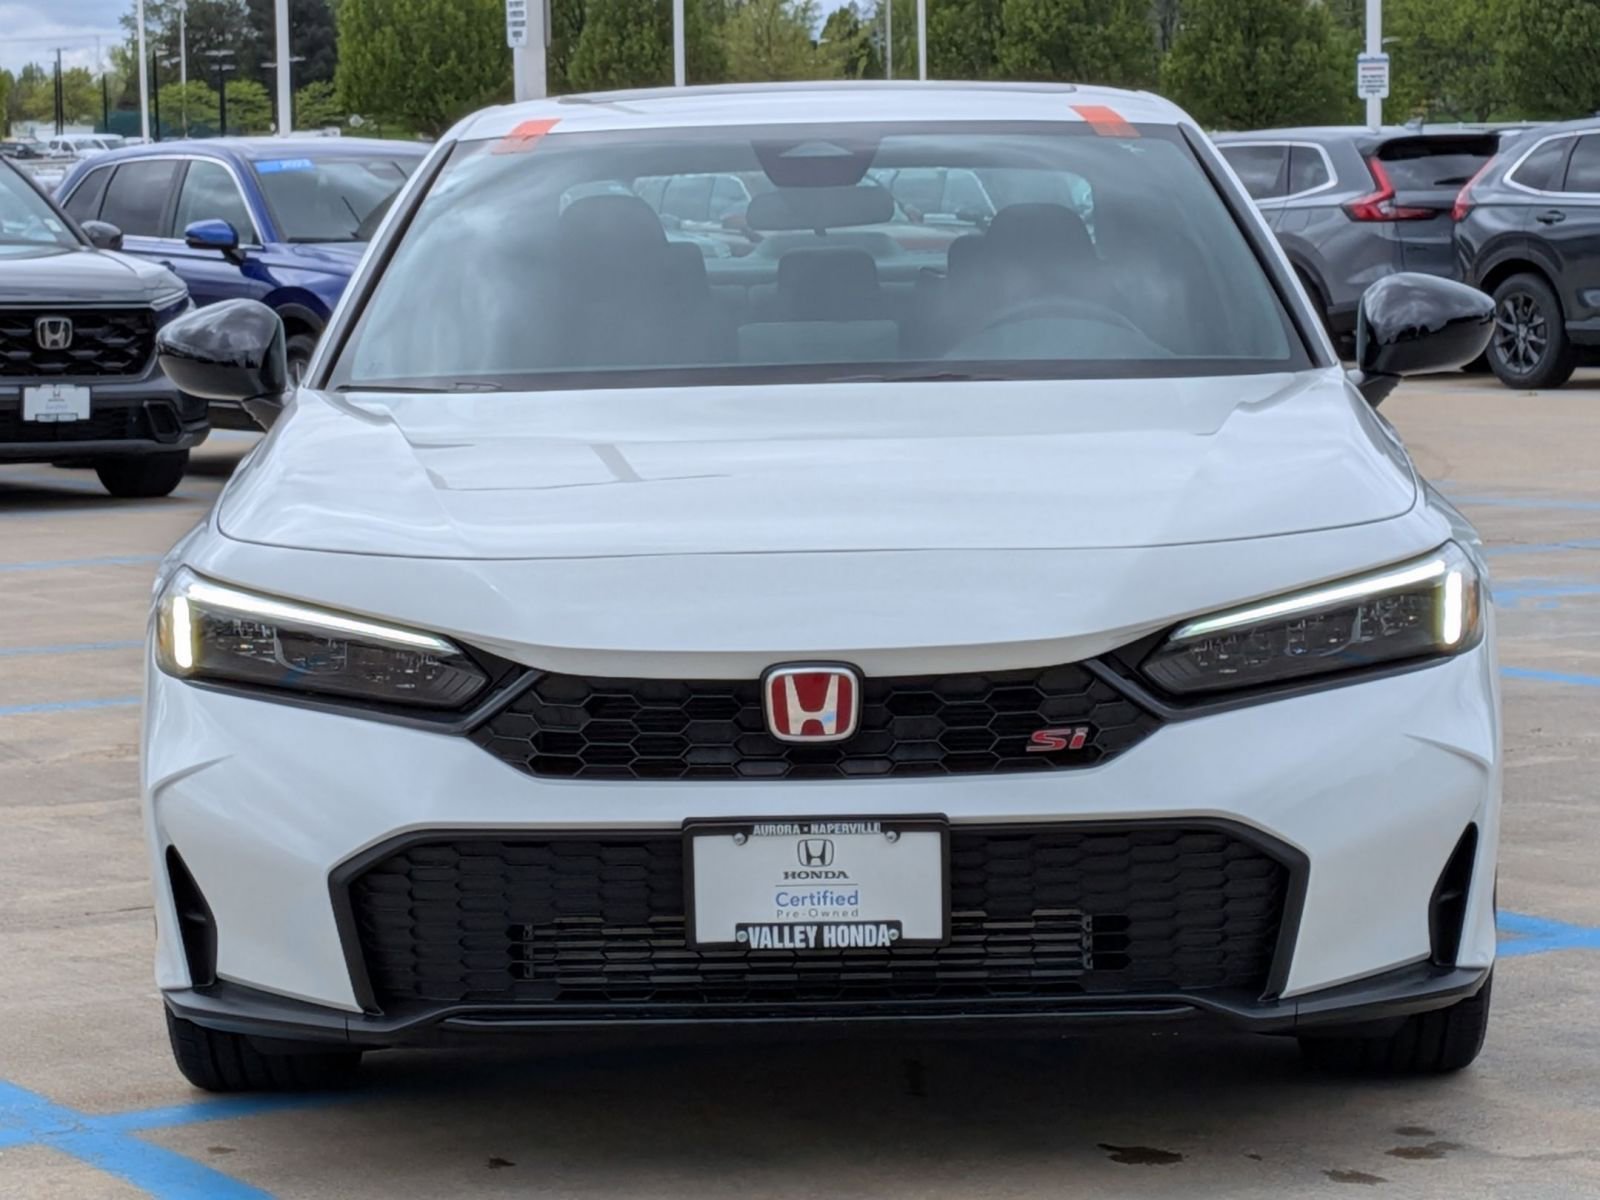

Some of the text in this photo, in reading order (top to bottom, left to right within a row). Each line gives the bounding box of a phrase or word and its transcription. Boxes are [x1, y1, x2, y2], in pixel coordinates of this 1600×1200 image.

[1026, 727, 1088, 752] Si
[753, 822, 881, 836] AURORA NAPERVILLE
[783, 870, 849, 880] HONDA
[775, 889, 859, 907] Certified
[776, 908, 859, 919] Pre-Owned
[748, 924, 891, 949] VALLEY HONDA
